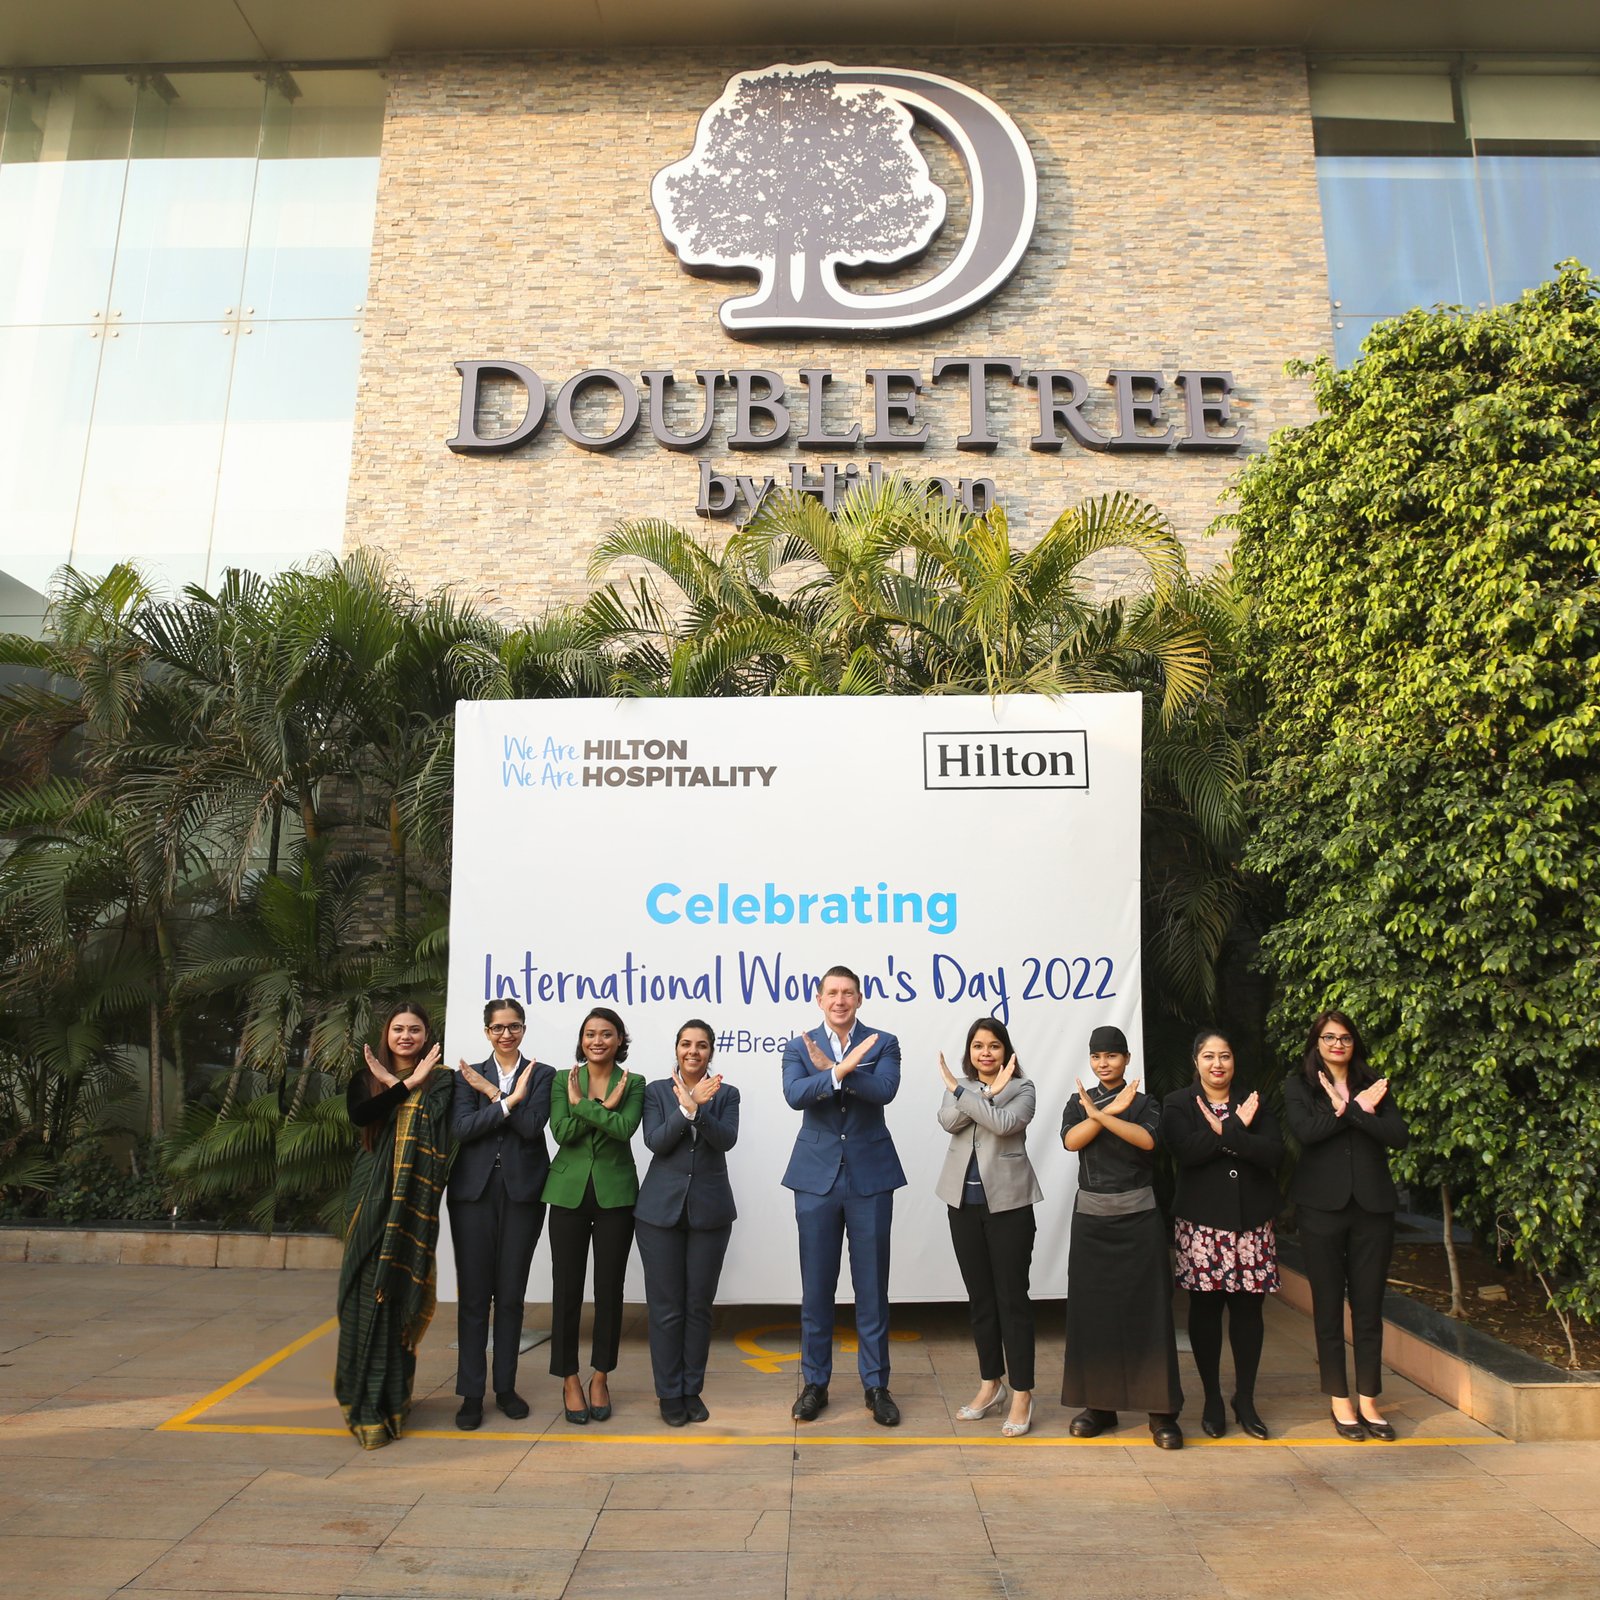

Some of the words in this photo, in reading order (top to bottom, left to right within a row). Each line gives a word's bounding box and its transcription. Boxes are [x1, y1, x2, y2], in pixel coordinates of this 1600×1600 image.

[445, 357, 1247, 453] DOUBLETREE
[695, 460, 775, 531] by
[502, 761, 536, 788] We
[541, 762, 579, 790] Are
[582, 766, 778, 787] HOSPITALITY
[504, 735, 538, 761] We
[542, 735, 580, 763] Are
[583, 739, 688, 760] HILTON
[937, 744, 1076, 777] Hilton
[646, 881, 958, 935] Celebrating
[484, 951, 722, 1006] International
[738, 951, 917, 1005] Won's
[932, 953, 1011, 1028] Day
[1021, 957, 1118, 1000] 2022
